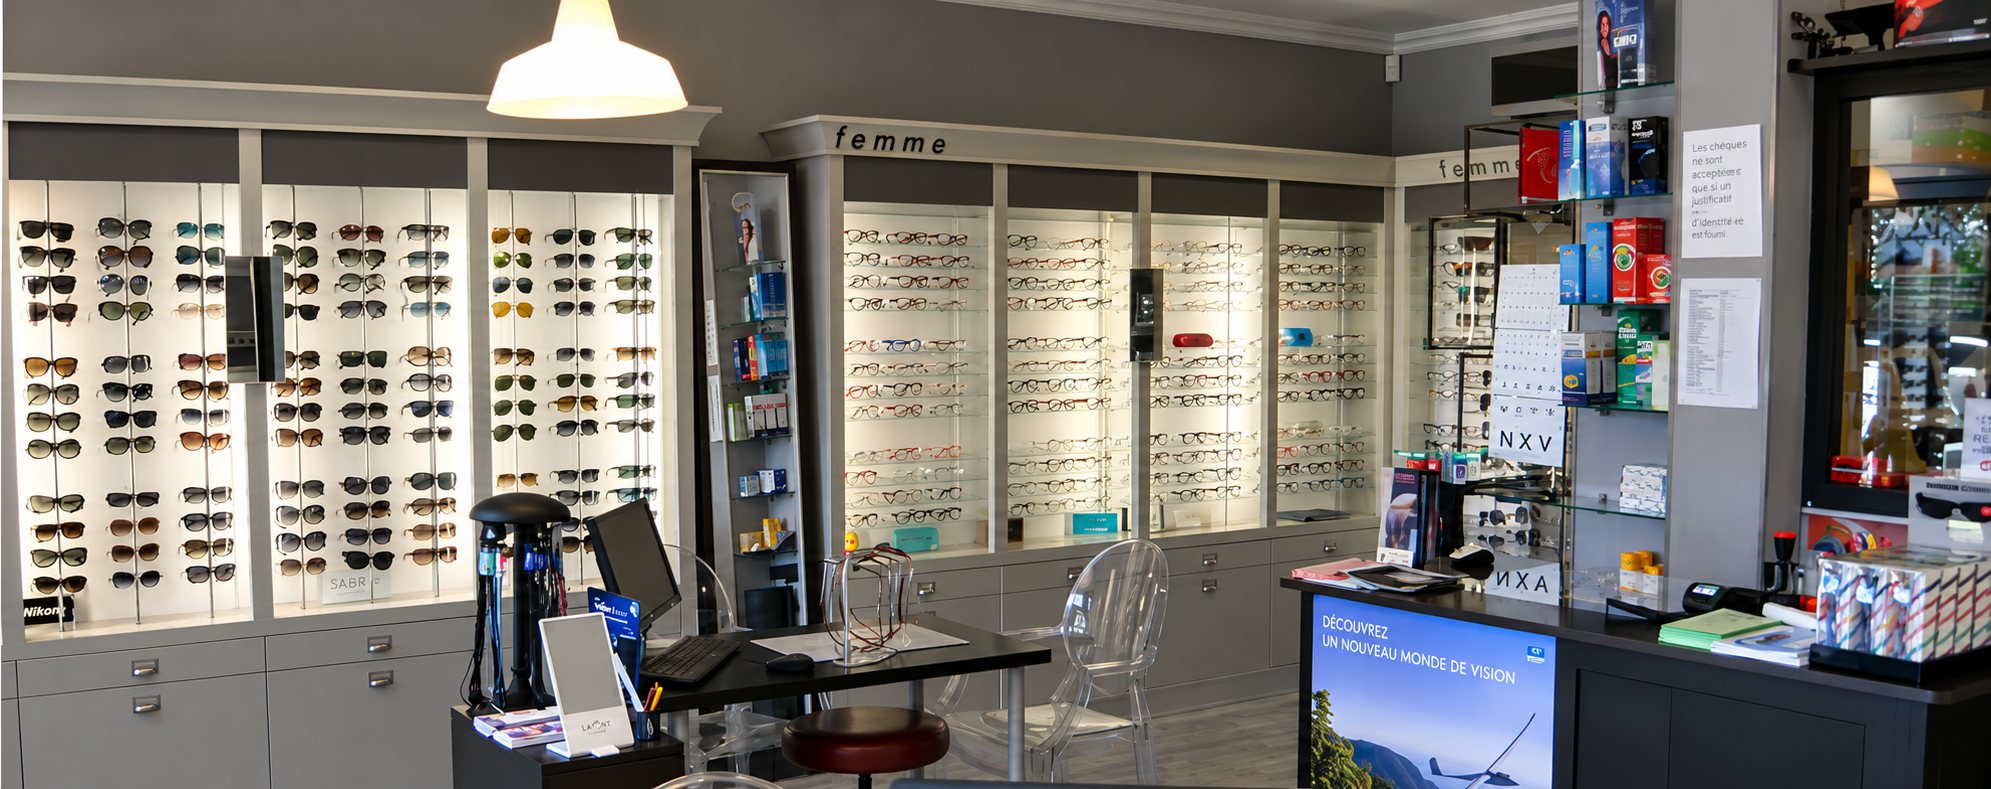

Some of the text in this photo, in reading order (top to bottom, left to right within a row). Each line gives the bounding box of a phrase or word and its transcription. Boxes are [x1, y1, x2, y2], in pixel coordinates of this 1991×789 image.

[835, 125, 946, 154] femme
[1692, 141, 1748, 153] Les chèques
[1692, 156, 1723, 166] ne sont
[1692, 182, 1732, 194] que si un
[1691, 194, 1733, 208] justificatif
[1692, 231, 1703, 239] est
[1322, 613, 1389, 640] DÉCOUVREZ
[1322, 634, 1516, 684] UN NOUVEAU MONDE DE VISION
